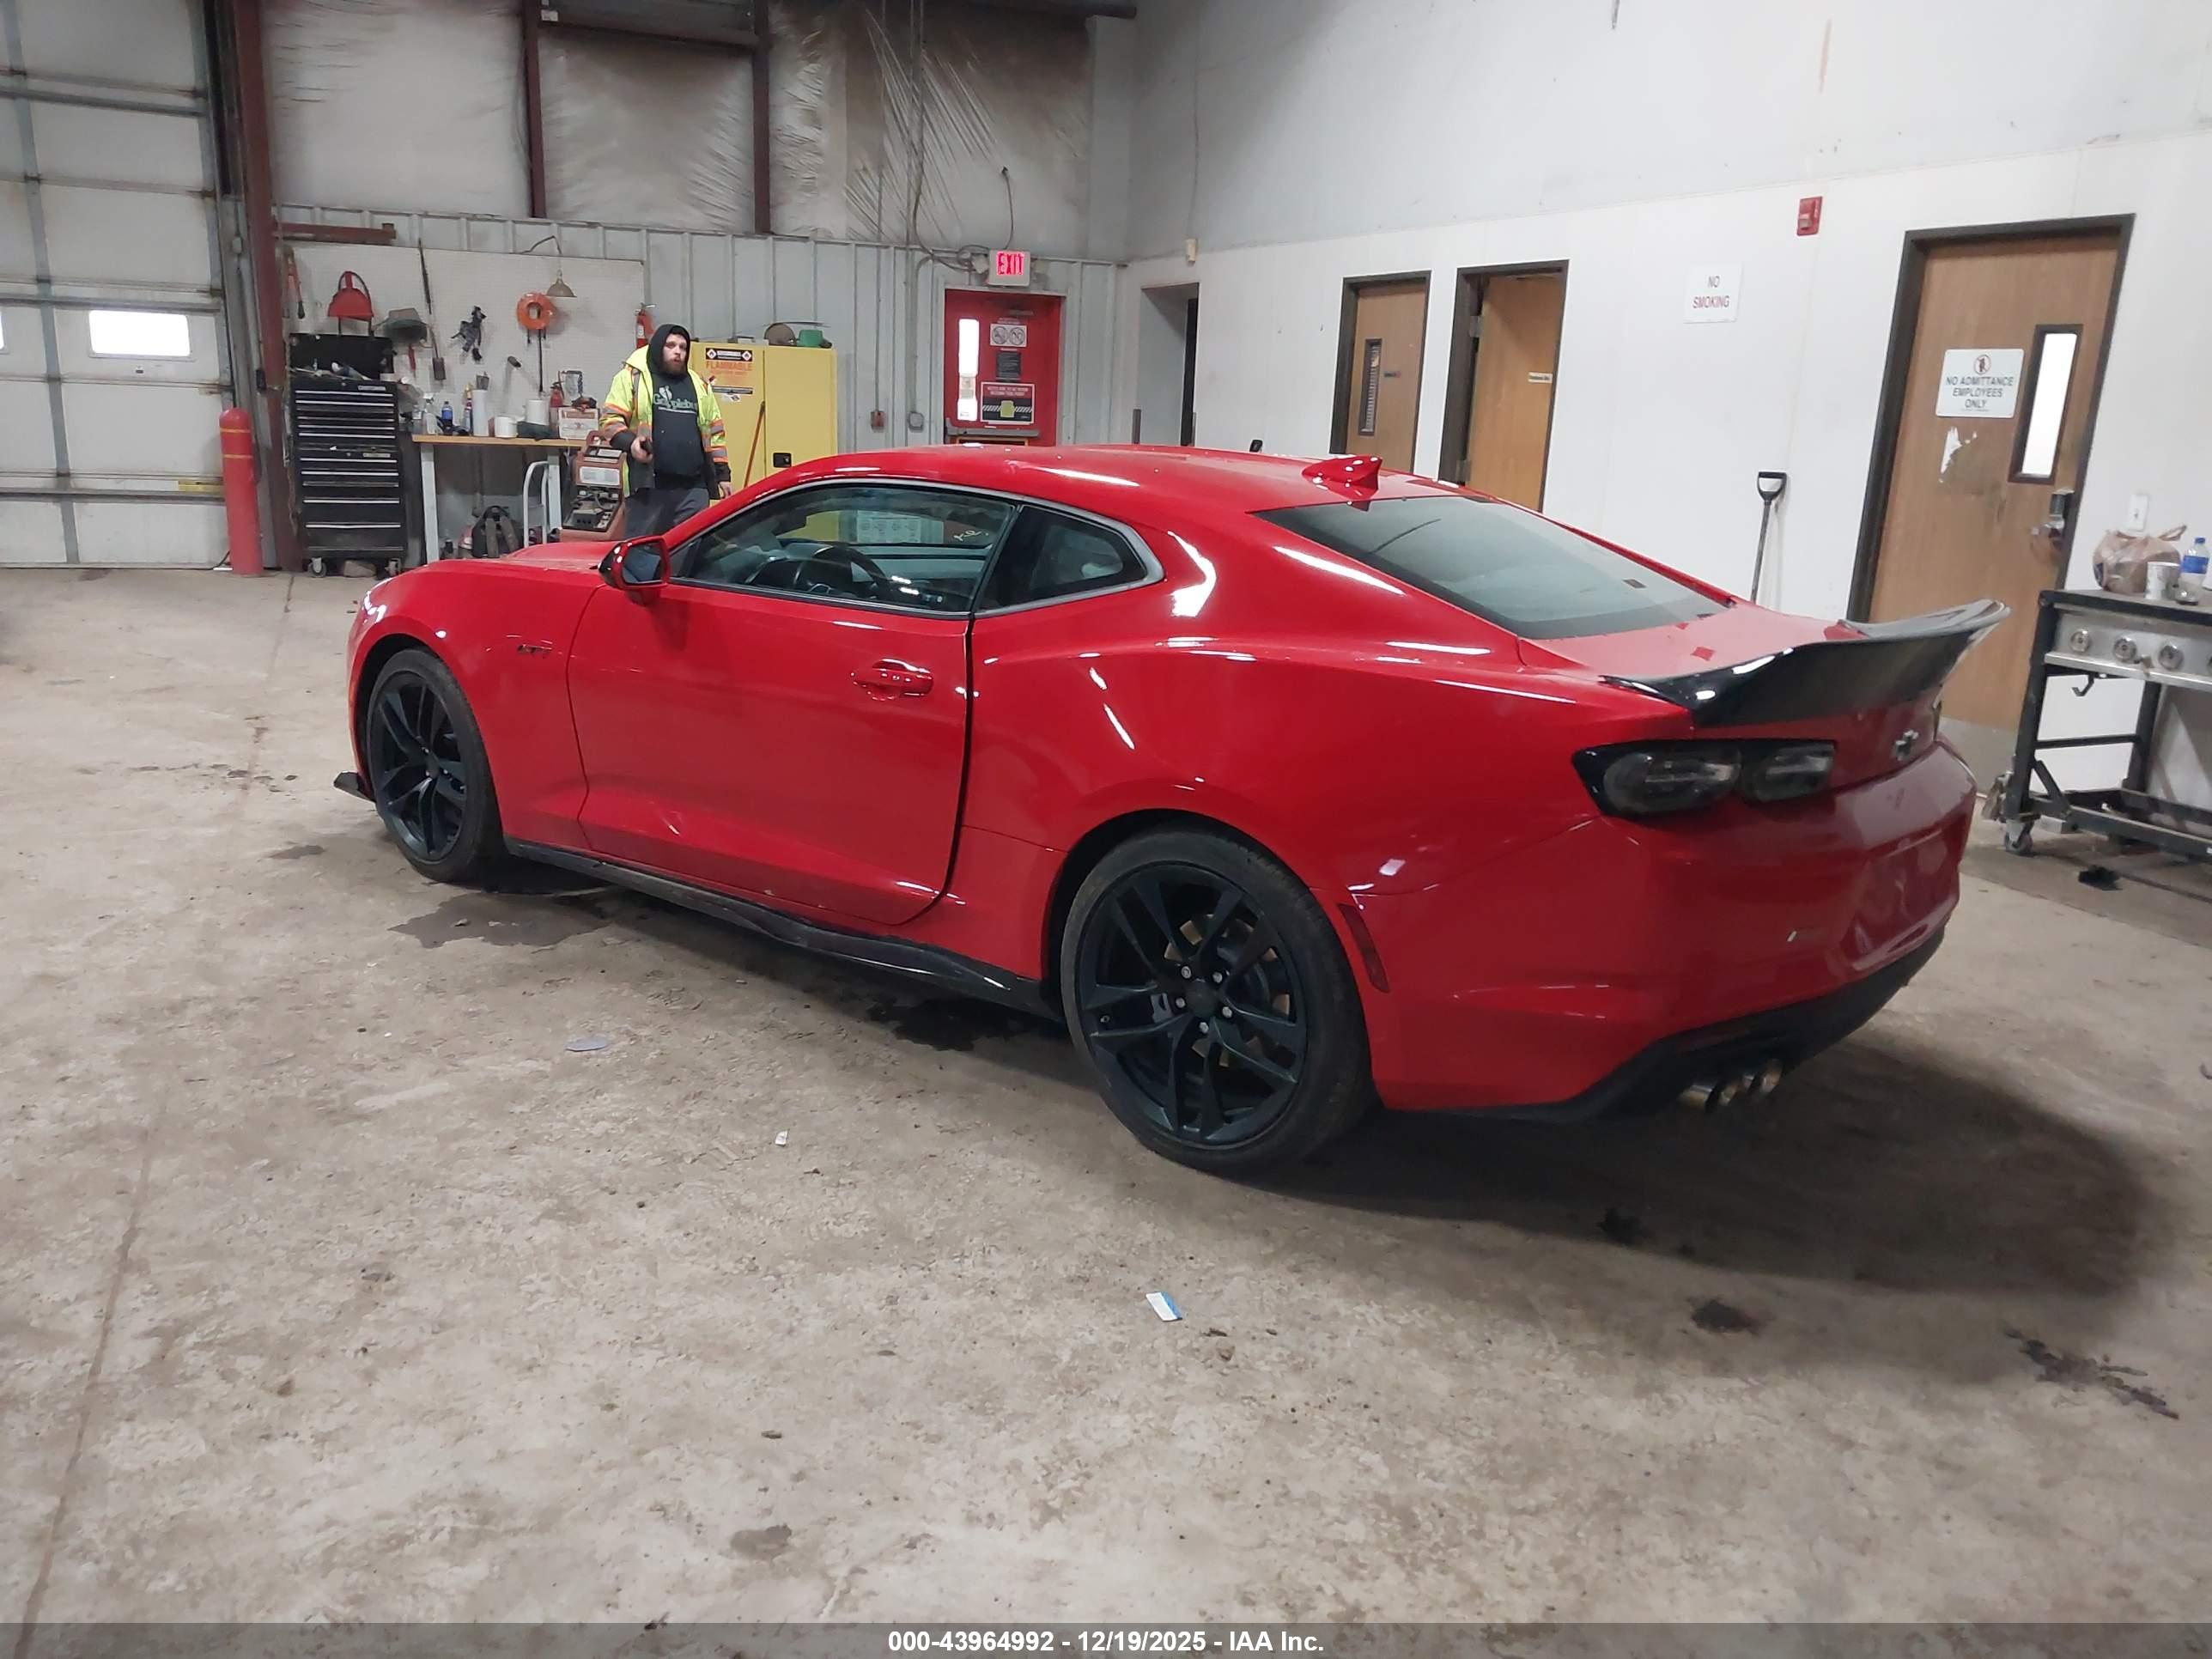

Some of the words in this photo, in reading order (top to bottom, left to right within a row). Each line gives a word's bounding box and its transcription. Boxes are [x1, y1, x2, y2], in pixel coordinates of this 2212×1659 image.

[996, 251, 1025, 276] EXIT
[1707, 275, 1721, 289] NO
[1692, 295, 1730, 309] SMOKING
[1945, 376, 1959, 386] NO
[1960, 376, 2014, 386] ADMITTANCE
[1952, 387, 2004, 398] EMPLOYEES
[1964, 398, 1988, 409] ONLY
